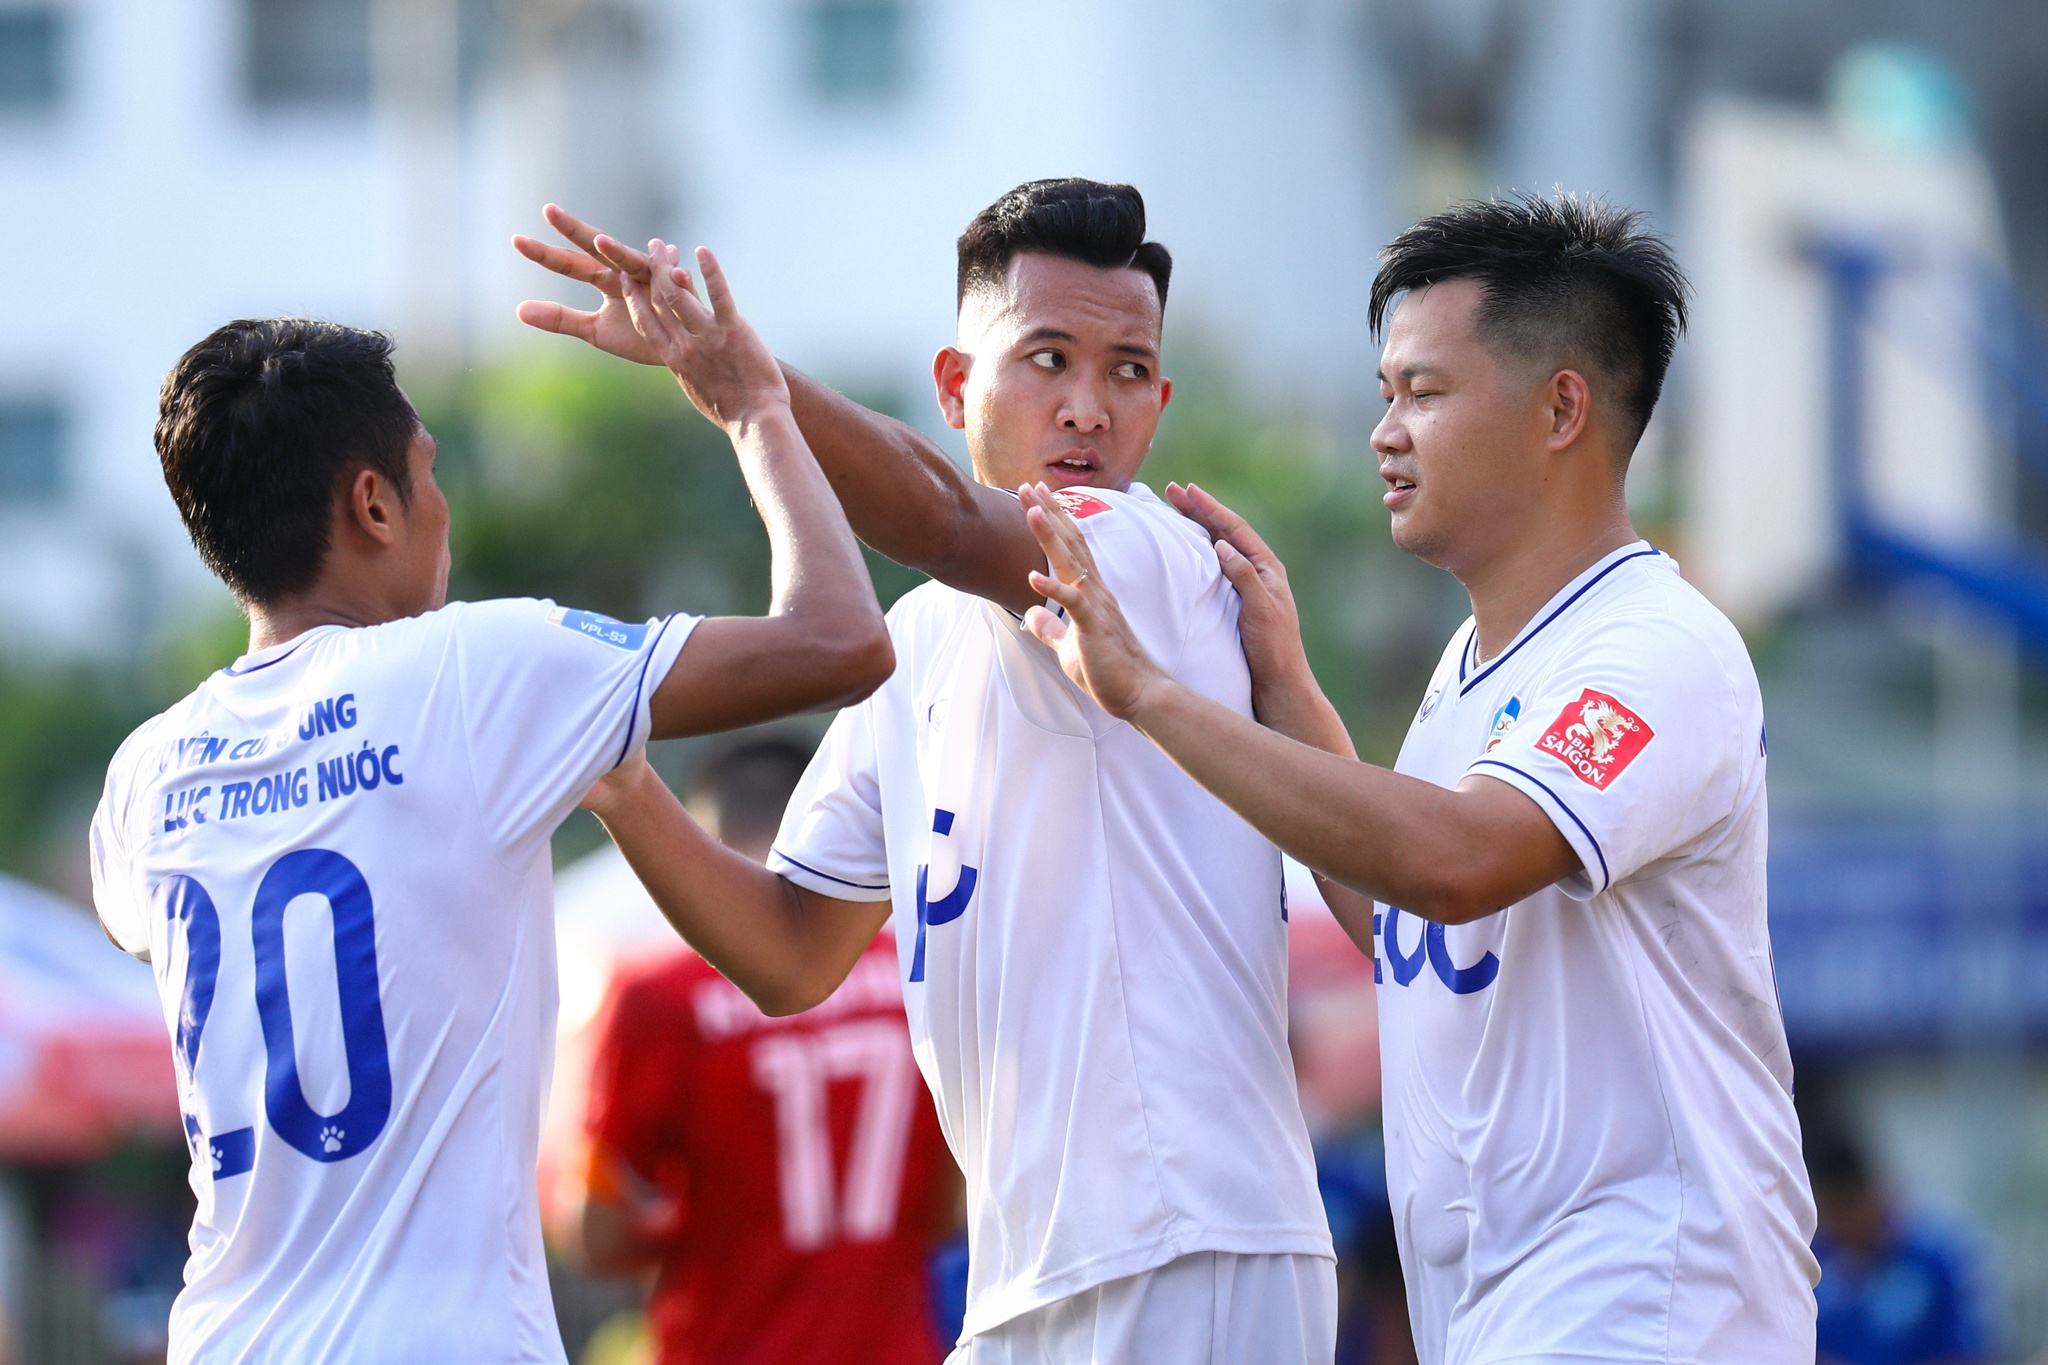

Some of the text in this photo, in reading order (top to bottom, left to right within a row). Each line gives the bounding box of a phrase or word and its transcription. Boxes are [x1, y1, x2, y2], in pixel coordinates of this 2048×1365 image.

[580, 621, 628, 644] VPL-S3
[1541, 735, 1605, 783] SAIGON
[1571, 737, 1591, 758] BIA
[219, 767, 308, 820] TRONG
[317, 740, 404, 802] NƯỚC
[148, 848, 393, 1182] 20
[753, 1018, 919, 1252] 17
